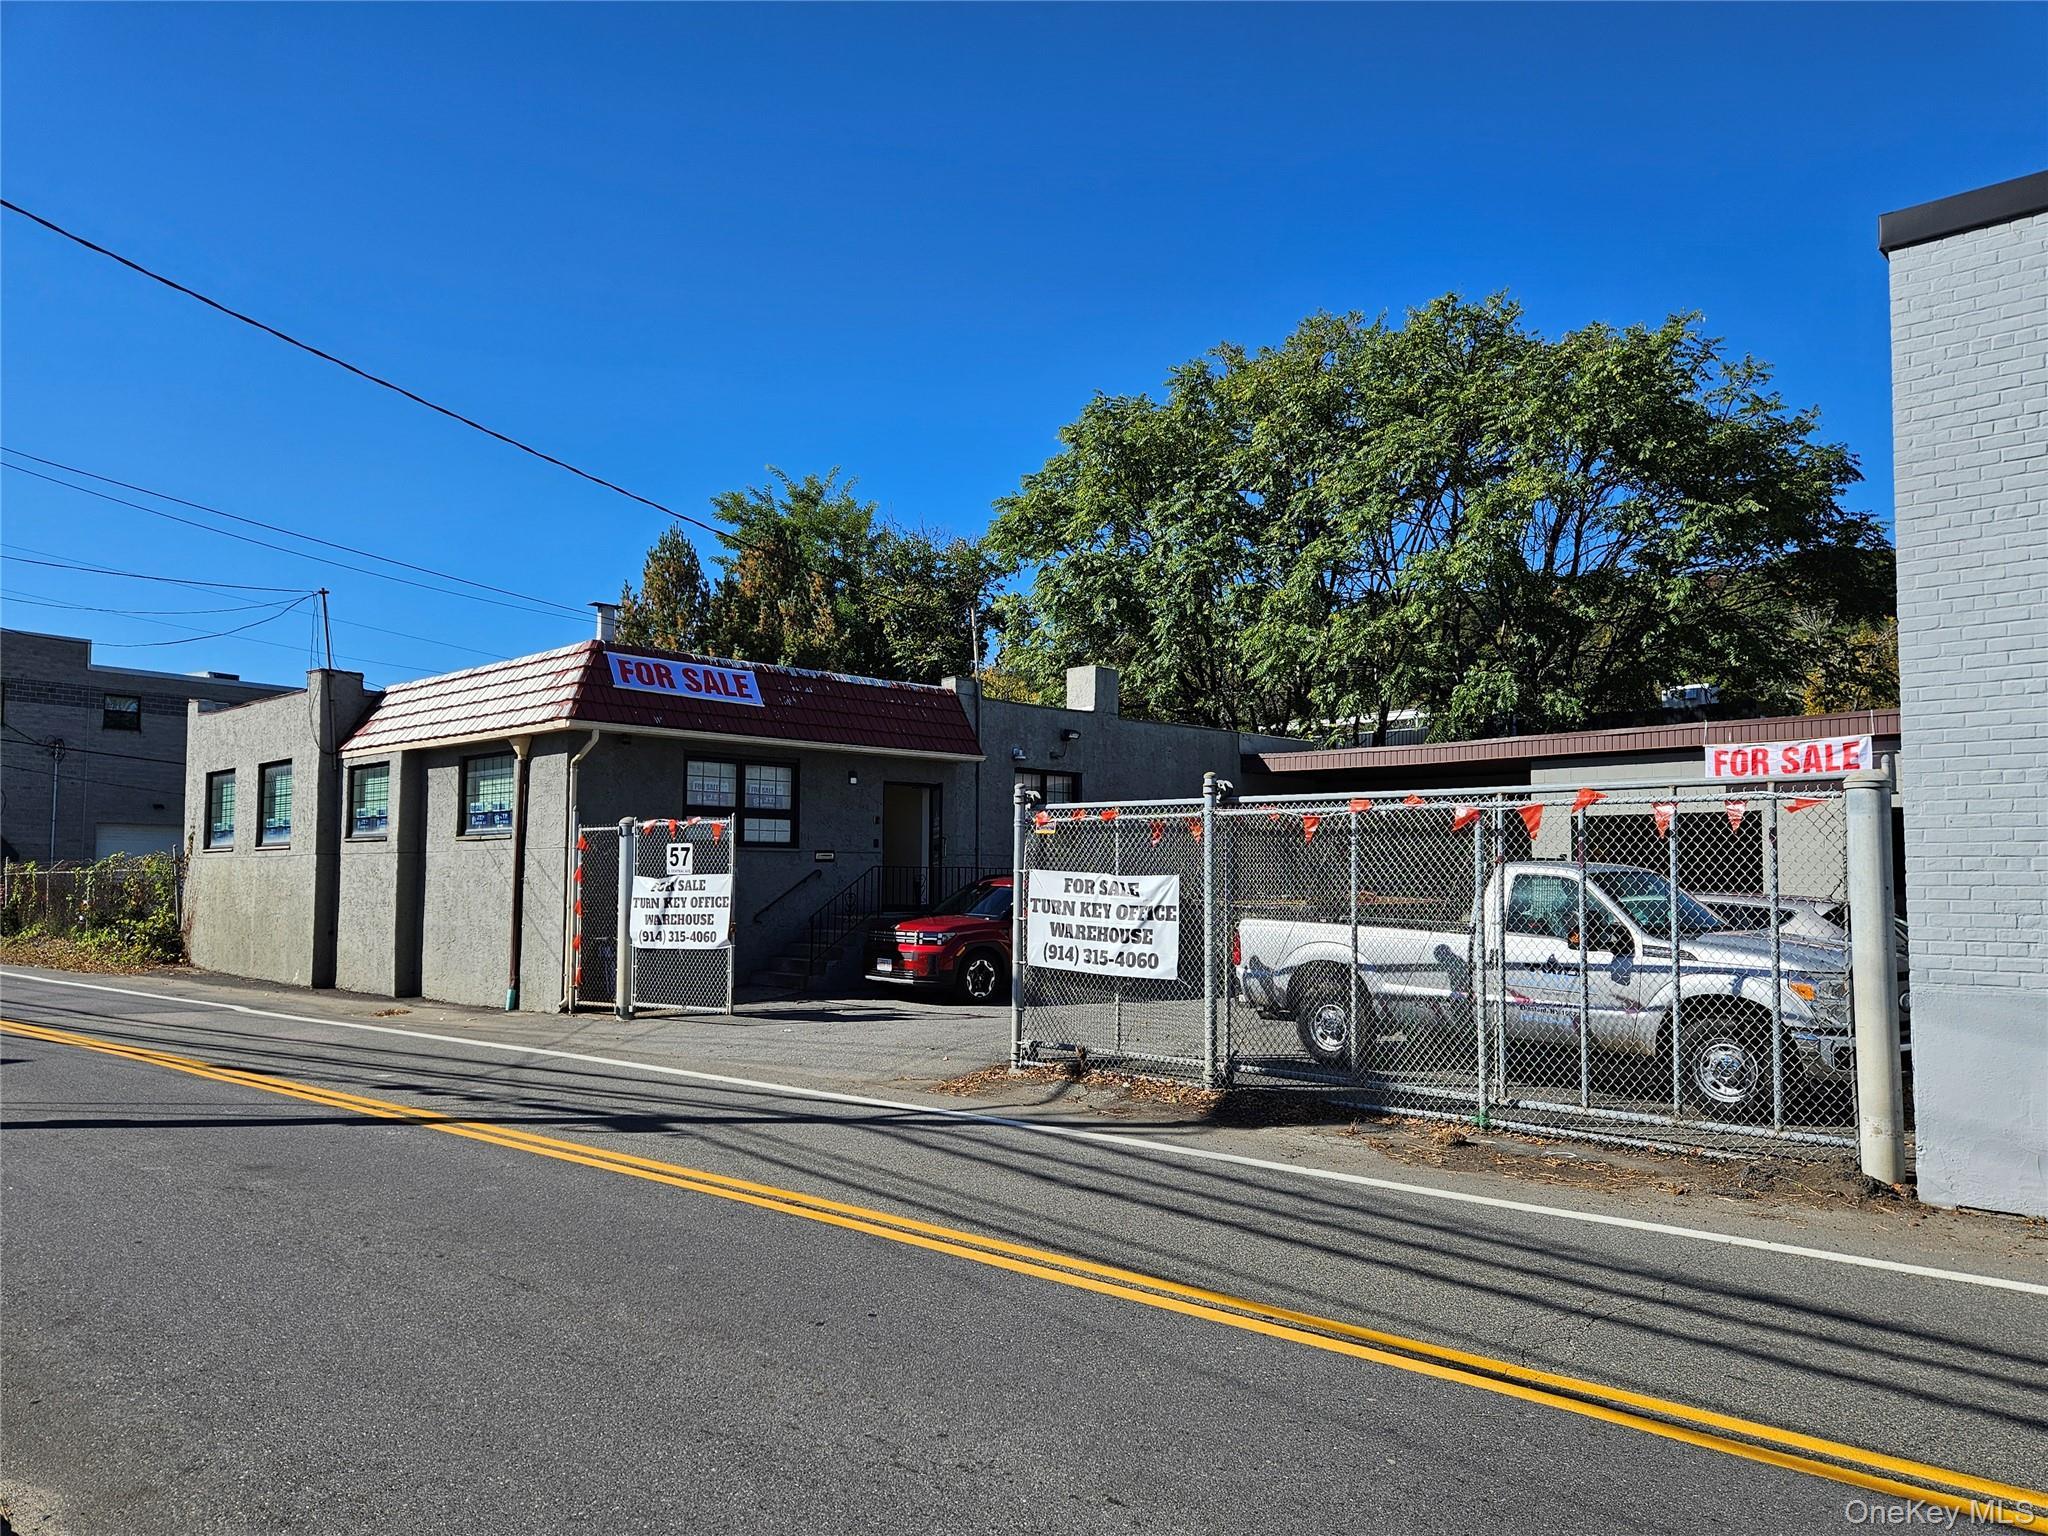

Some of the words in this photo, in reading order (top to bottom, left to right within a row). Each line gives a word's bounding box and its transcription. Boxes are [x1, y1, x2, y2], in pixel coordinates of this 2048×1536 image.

[616, 658, 677, 689] FOR
[681, 667, 753, 698] SALE
[1713, 748, 1769, 776] FOR
[1780, 741, 1861, 774] SALE
[669, 846, 691, 866] 57
[678, 880, 706, 891] SALE
[1063, 878, 1096, 895] FOR
[1099, 880, 1140, 897] SALE
[633, 897, 660, 909] TURN
[663, 896, 687, 908] KEY
[690, 896, 729, 908] OFFICE
[1030, 898, 1075, 917] TURN
[1079, 901, 1112, 919] KEY
[1115, 904, 1177, 922] OFFICE
[645, 914, 714, 925] WAREHOUSE
[639, 929, 666, 944] (914)
[668, 931, 717, 942] 315-4060
[1050, 922, 1153, 945] WAREHOUSE
[1043, 942, 1079, 967] (914)
[1083, 948, 1159, 969] 315-4060
